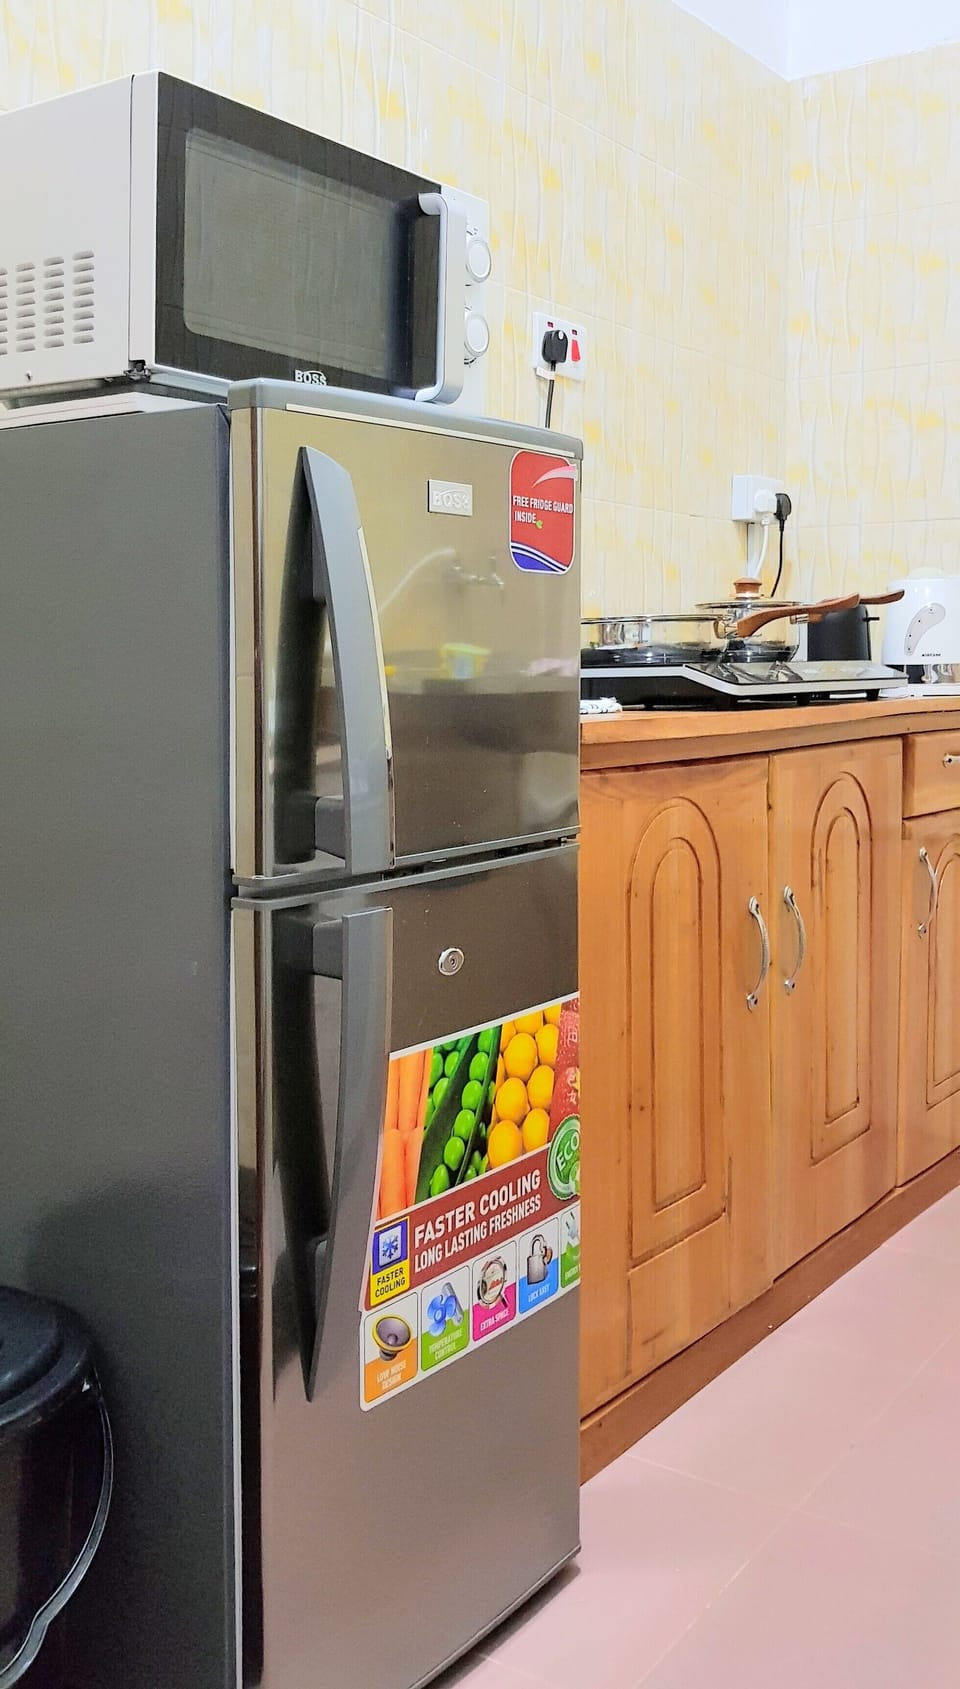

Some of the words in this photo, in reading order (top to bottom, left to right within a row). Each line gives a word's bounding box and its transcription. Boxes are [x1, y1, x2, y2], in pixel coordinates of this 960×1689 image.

[295, 369, 327, 386] BOSS
[512, 495, 529, 508] FREE
[530, 498, 553, 511] FRIDGE
[553, 501, 573, 514] GUARD
[514, 510, 537, 524] INSIDE
[556, 1131, 580, 1172] ECO
[414, 1202, 476, 1249] FASTER
[479, 1169, 541, 1215] COOLING
[414, 1244, 443, 1273] LONG
[445, 1222, 488, 1258] LASTING
[489, 1194, 542, 1236] FRESHNESS
[376, 1267, 404, 1287] FASTER
[375, 1278, 406, 1298] COOLING
[480, 1315, 495, 1331] EXTRA
